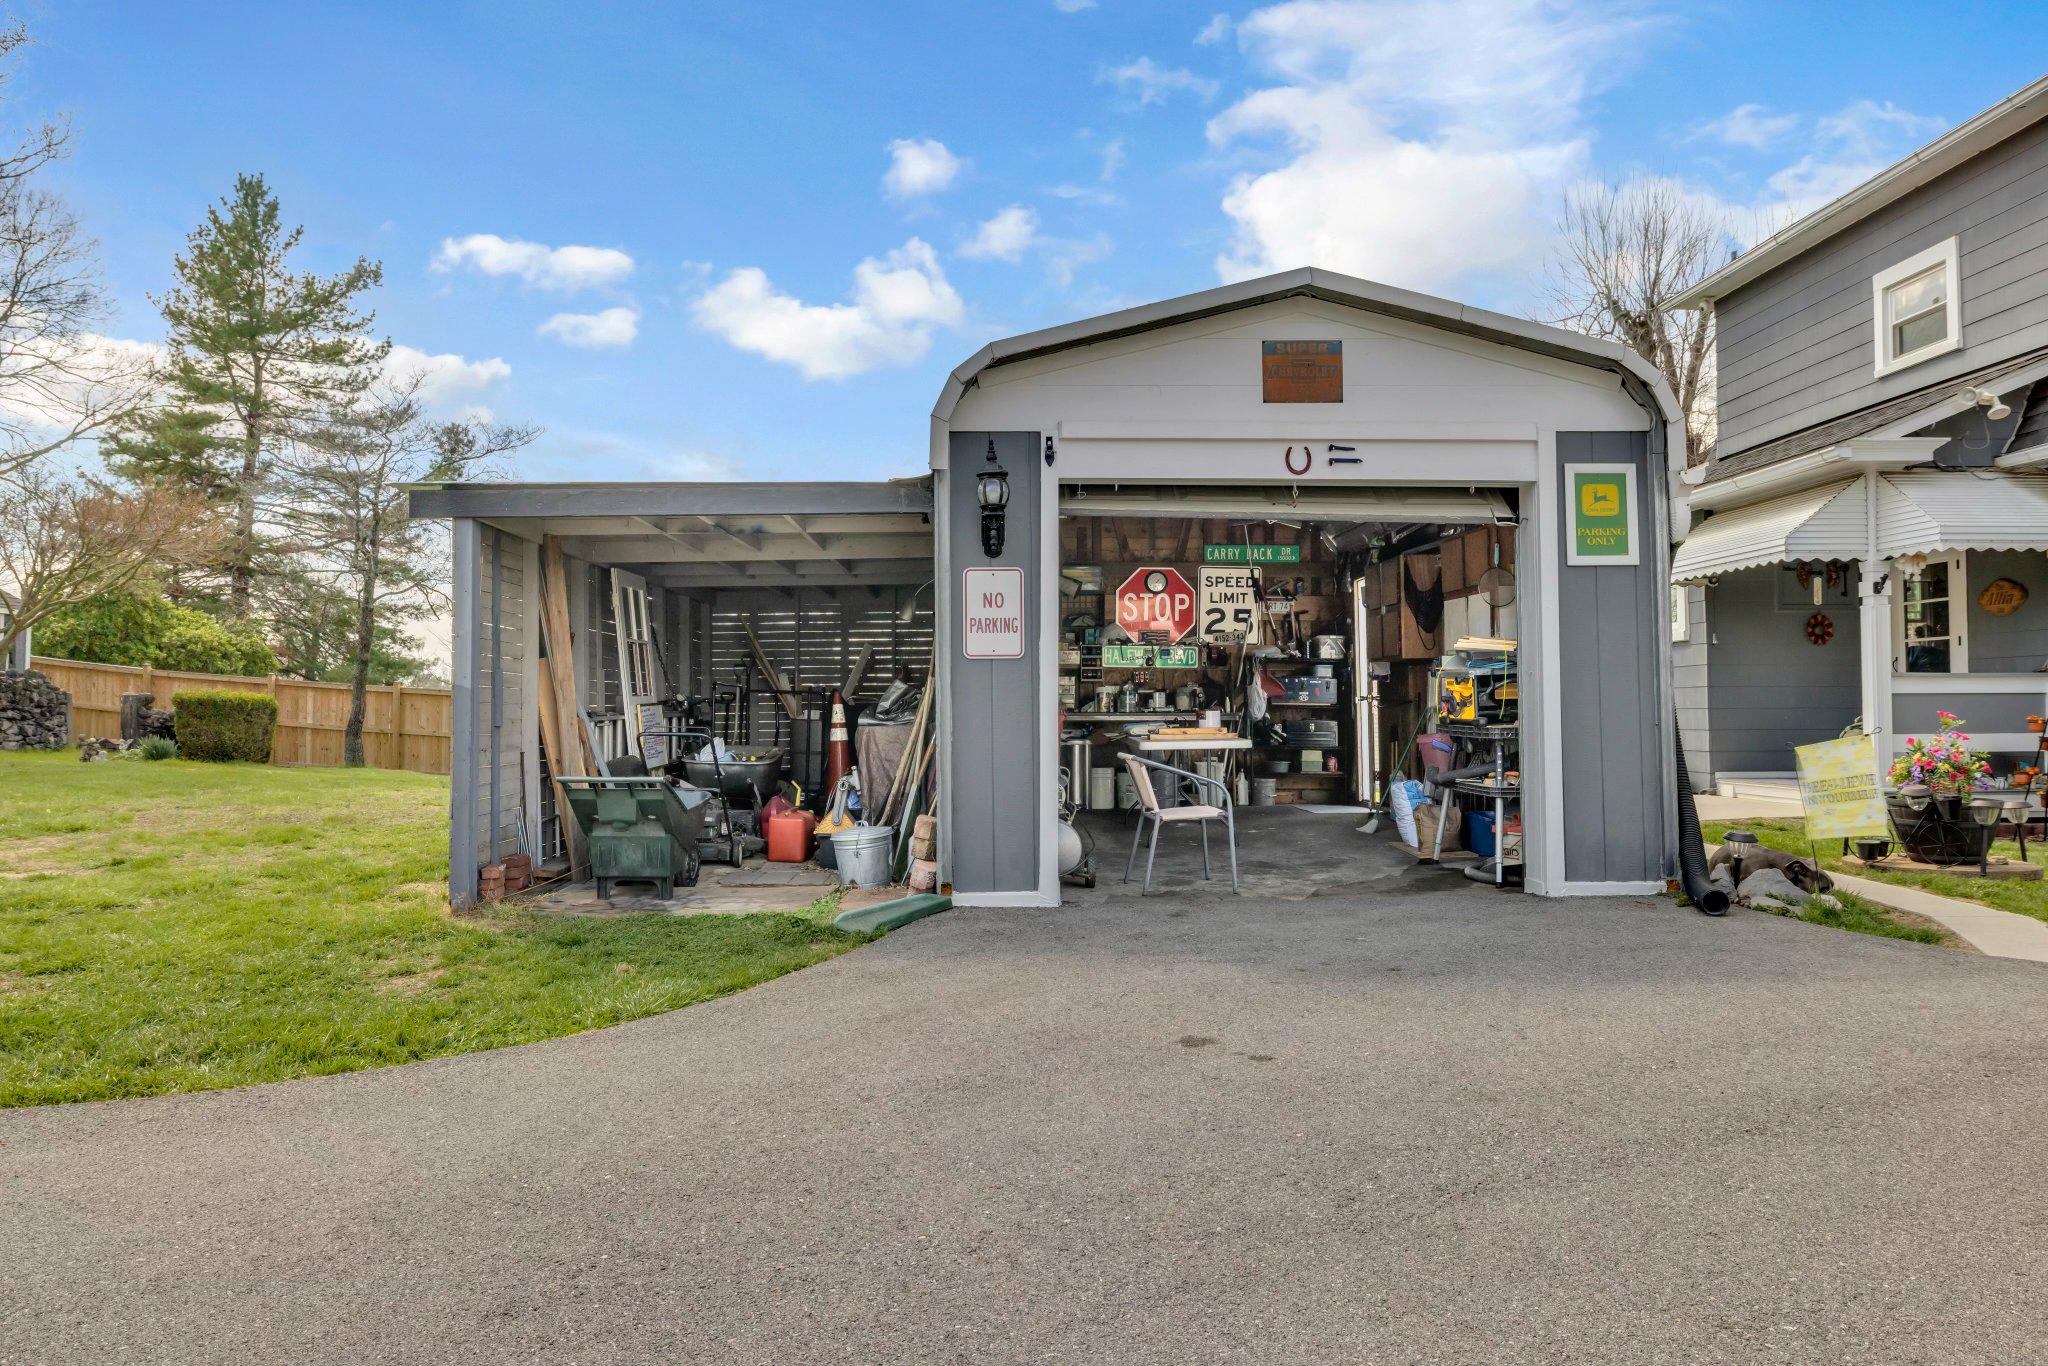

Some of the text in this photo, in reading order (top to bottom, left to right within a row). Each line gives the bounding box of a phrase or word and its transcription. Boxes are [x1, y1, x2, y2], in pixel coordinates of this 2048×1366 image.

[1577, 527, 1626, 536] PARKING
[1587, 536, 1616, 545] ONLY
[1207, 548, 1240, 560] CARRY
[1281, 547, 1291, 555] DR
[983, 592, 1004, 609] NO
[1209, 592, 1248, 604] LIMIT
[1122, 592, 1190, 622] STOP
[969, 617, 1019, 634] PARKING
[1204, 607, 1254, 635] 25
